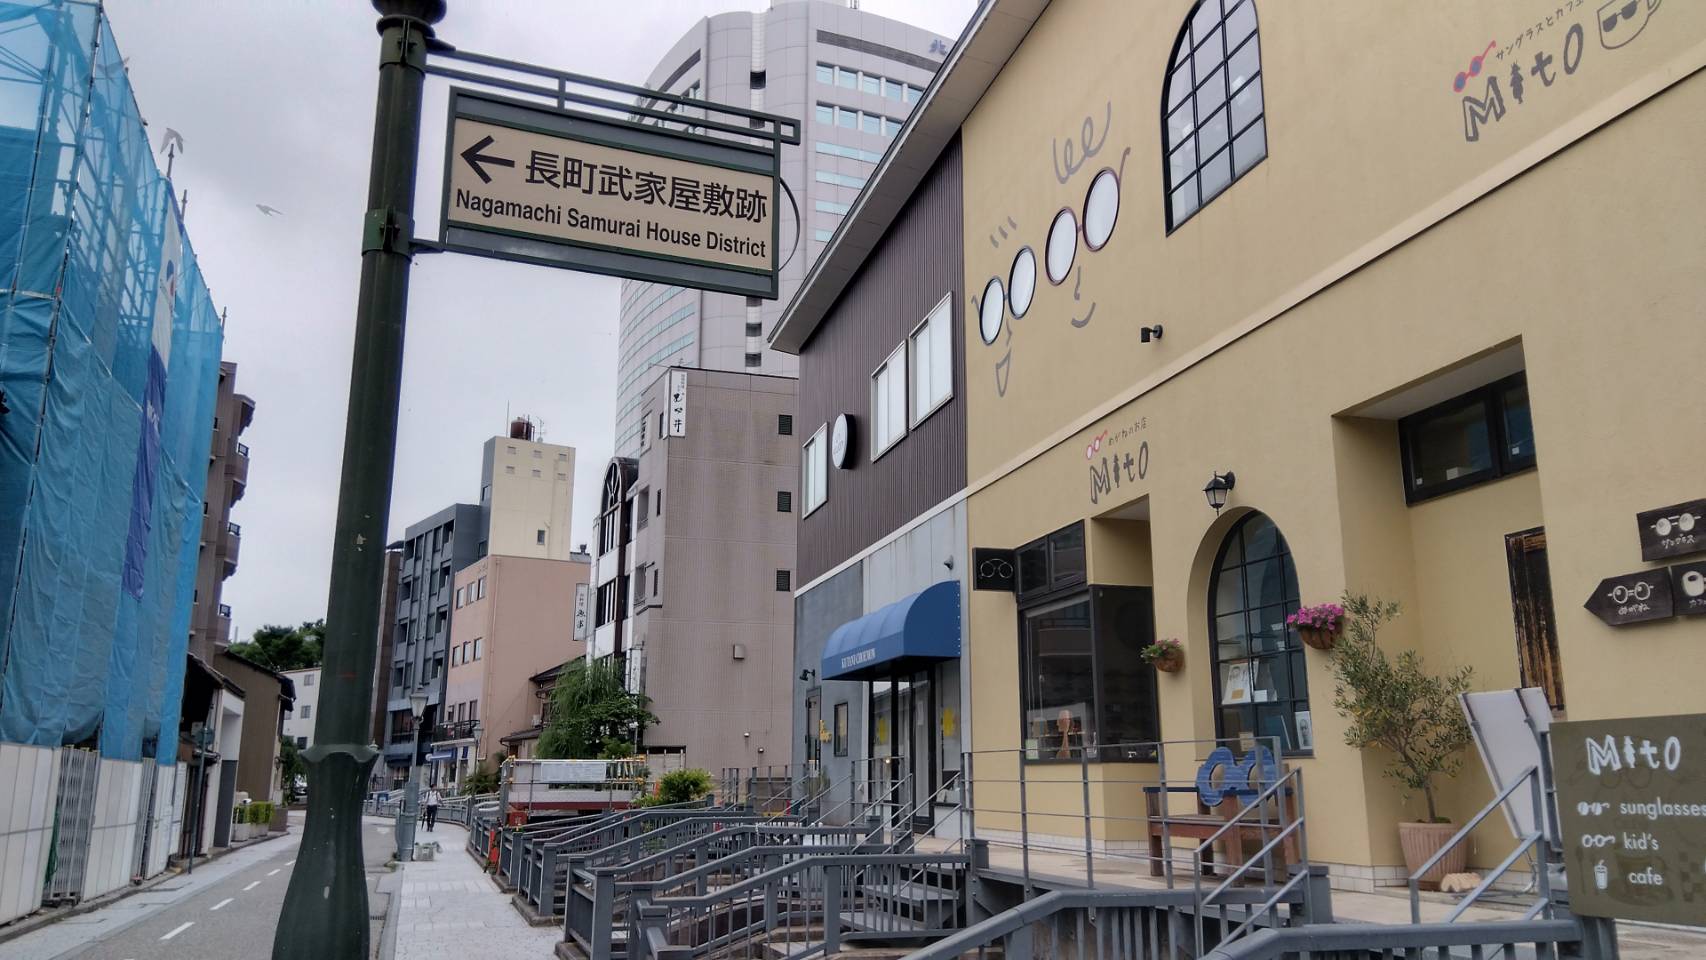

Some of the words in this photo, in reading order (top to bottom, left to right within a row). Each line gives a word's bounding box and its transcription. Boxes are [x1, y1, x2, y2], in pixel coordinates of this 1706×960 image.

[525, 150, 768, 223] 長町武家屋敷跡
[456, 188, 561, 225] Nagamachi
[567, 209, 641, 239] Samurai
[647, 221, 700, 247] House
[706, 232, 767, 258] District
[1620, 796, 1706, 820] sunglasses
[1623, 832, 1659, 851] kid's
[1628, 867, 1663, 886] cafe
